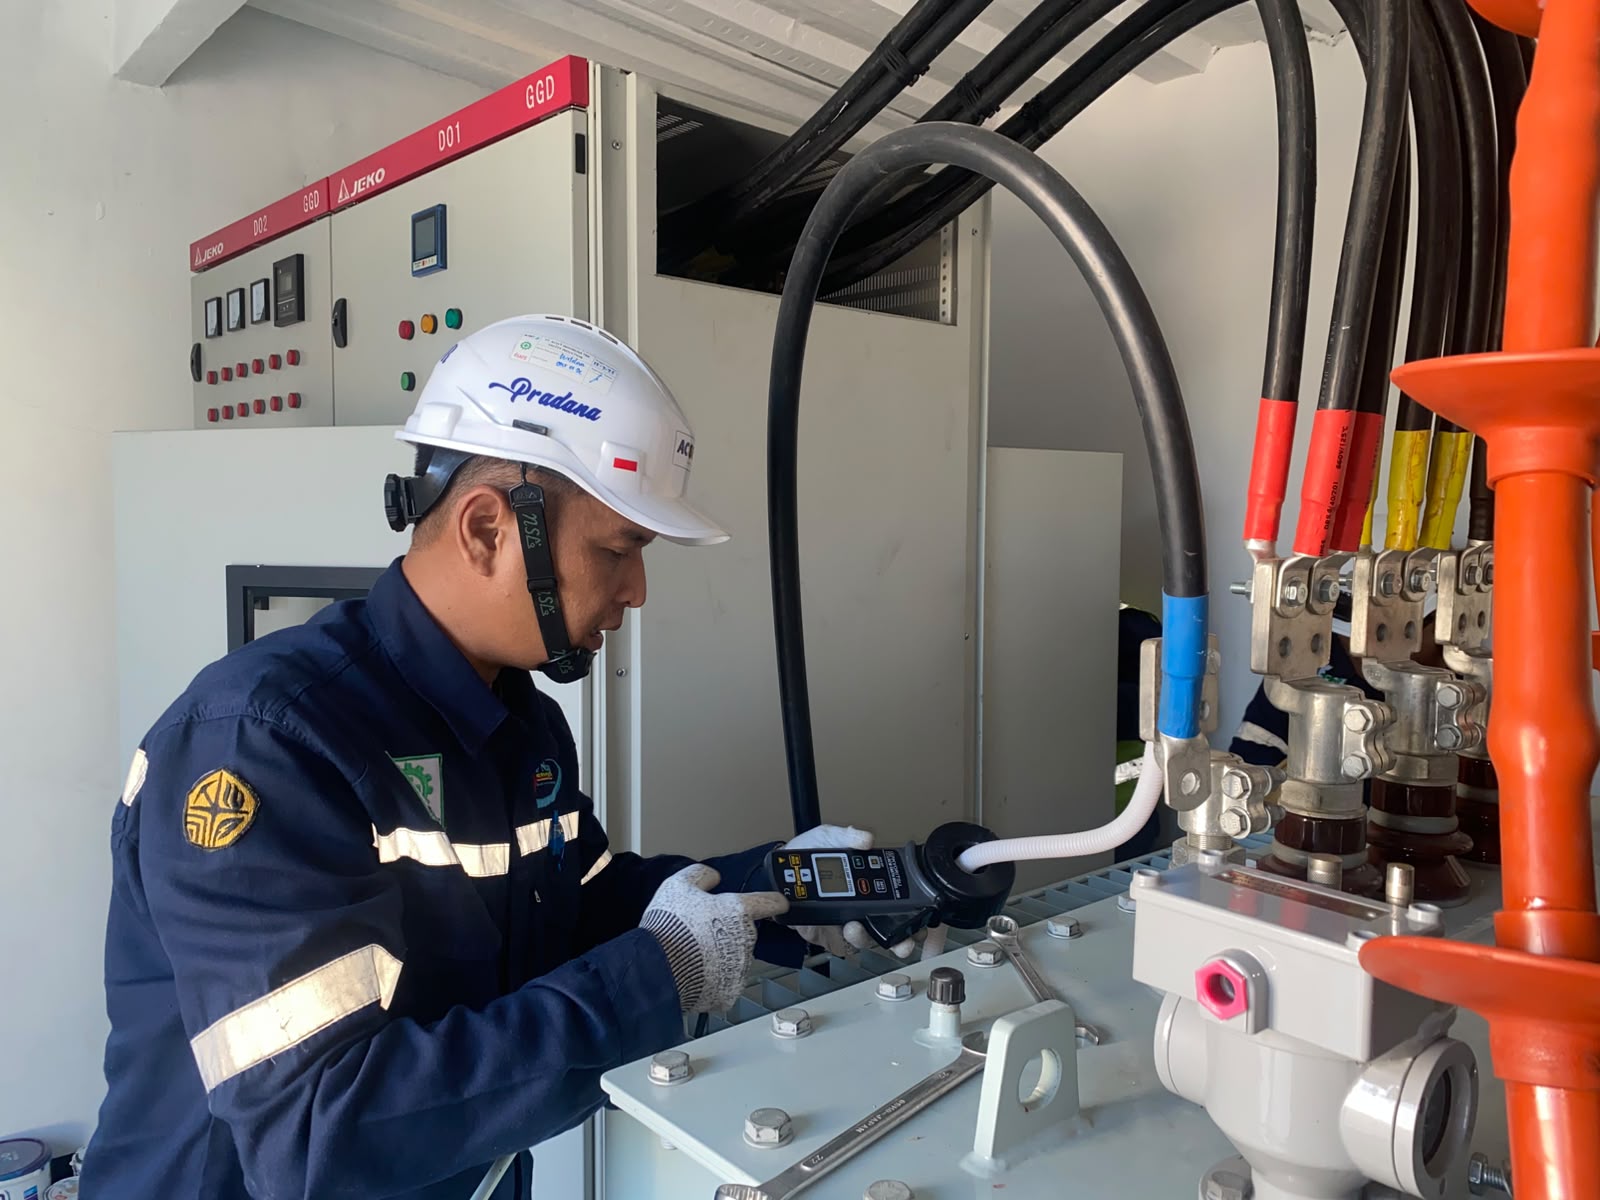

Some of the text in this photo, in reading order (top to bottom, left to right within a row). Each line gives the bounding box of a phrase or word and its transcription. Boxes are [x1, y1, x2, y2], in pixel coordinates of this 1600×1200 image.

[350, 167, 386, 197] JEKO
[525, 74, 555, 109] GGD
[202, 242, 224, 262] JEKO
[303, 189, 320, 213] GGD
[488, 377, 602, 421] Pradana
